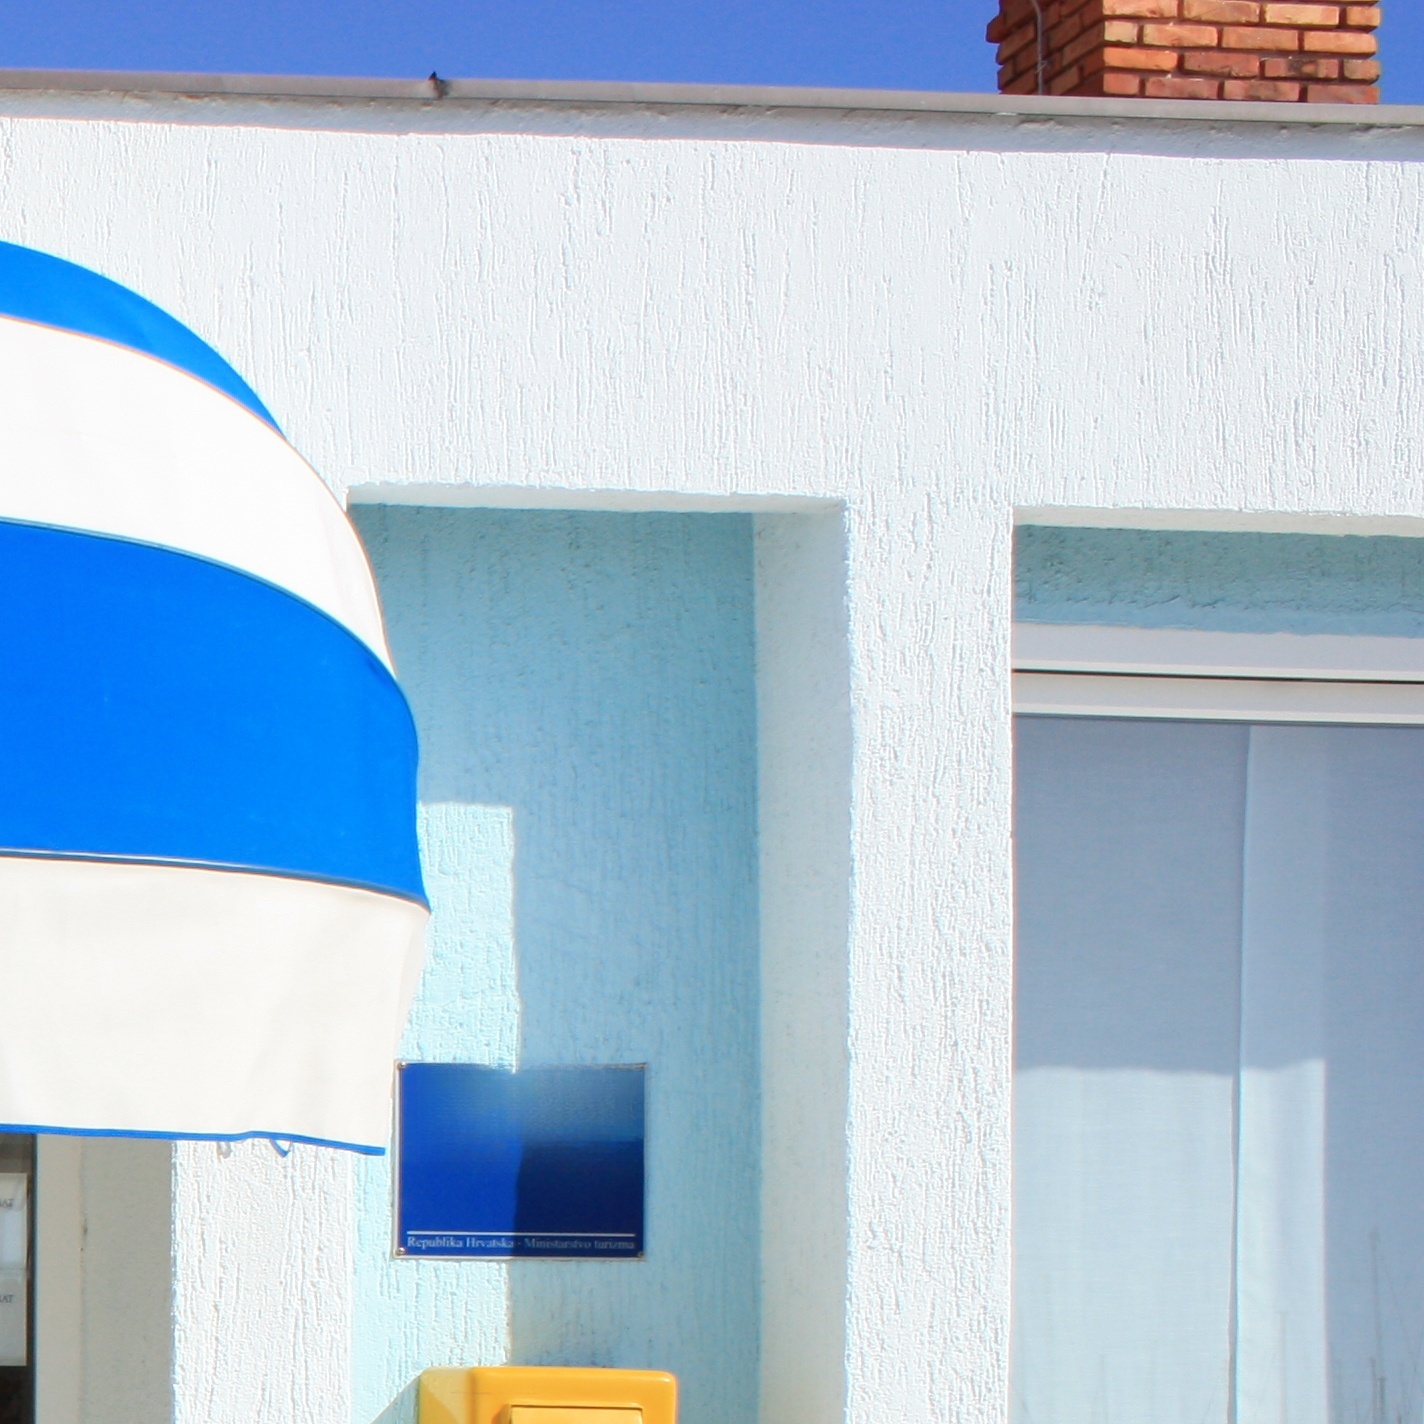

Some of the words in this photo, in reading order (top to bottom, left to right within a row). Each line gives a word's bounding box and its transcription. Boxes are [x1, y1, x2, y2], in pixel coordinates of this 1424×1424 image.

[407, 1236, 463, 1249] Republika
[466, 1237, 514, 1248] Hrvatska
[525, 1237, 591, 1249] Ministarstvo
[594, 1239, 635, 1249] turizma
